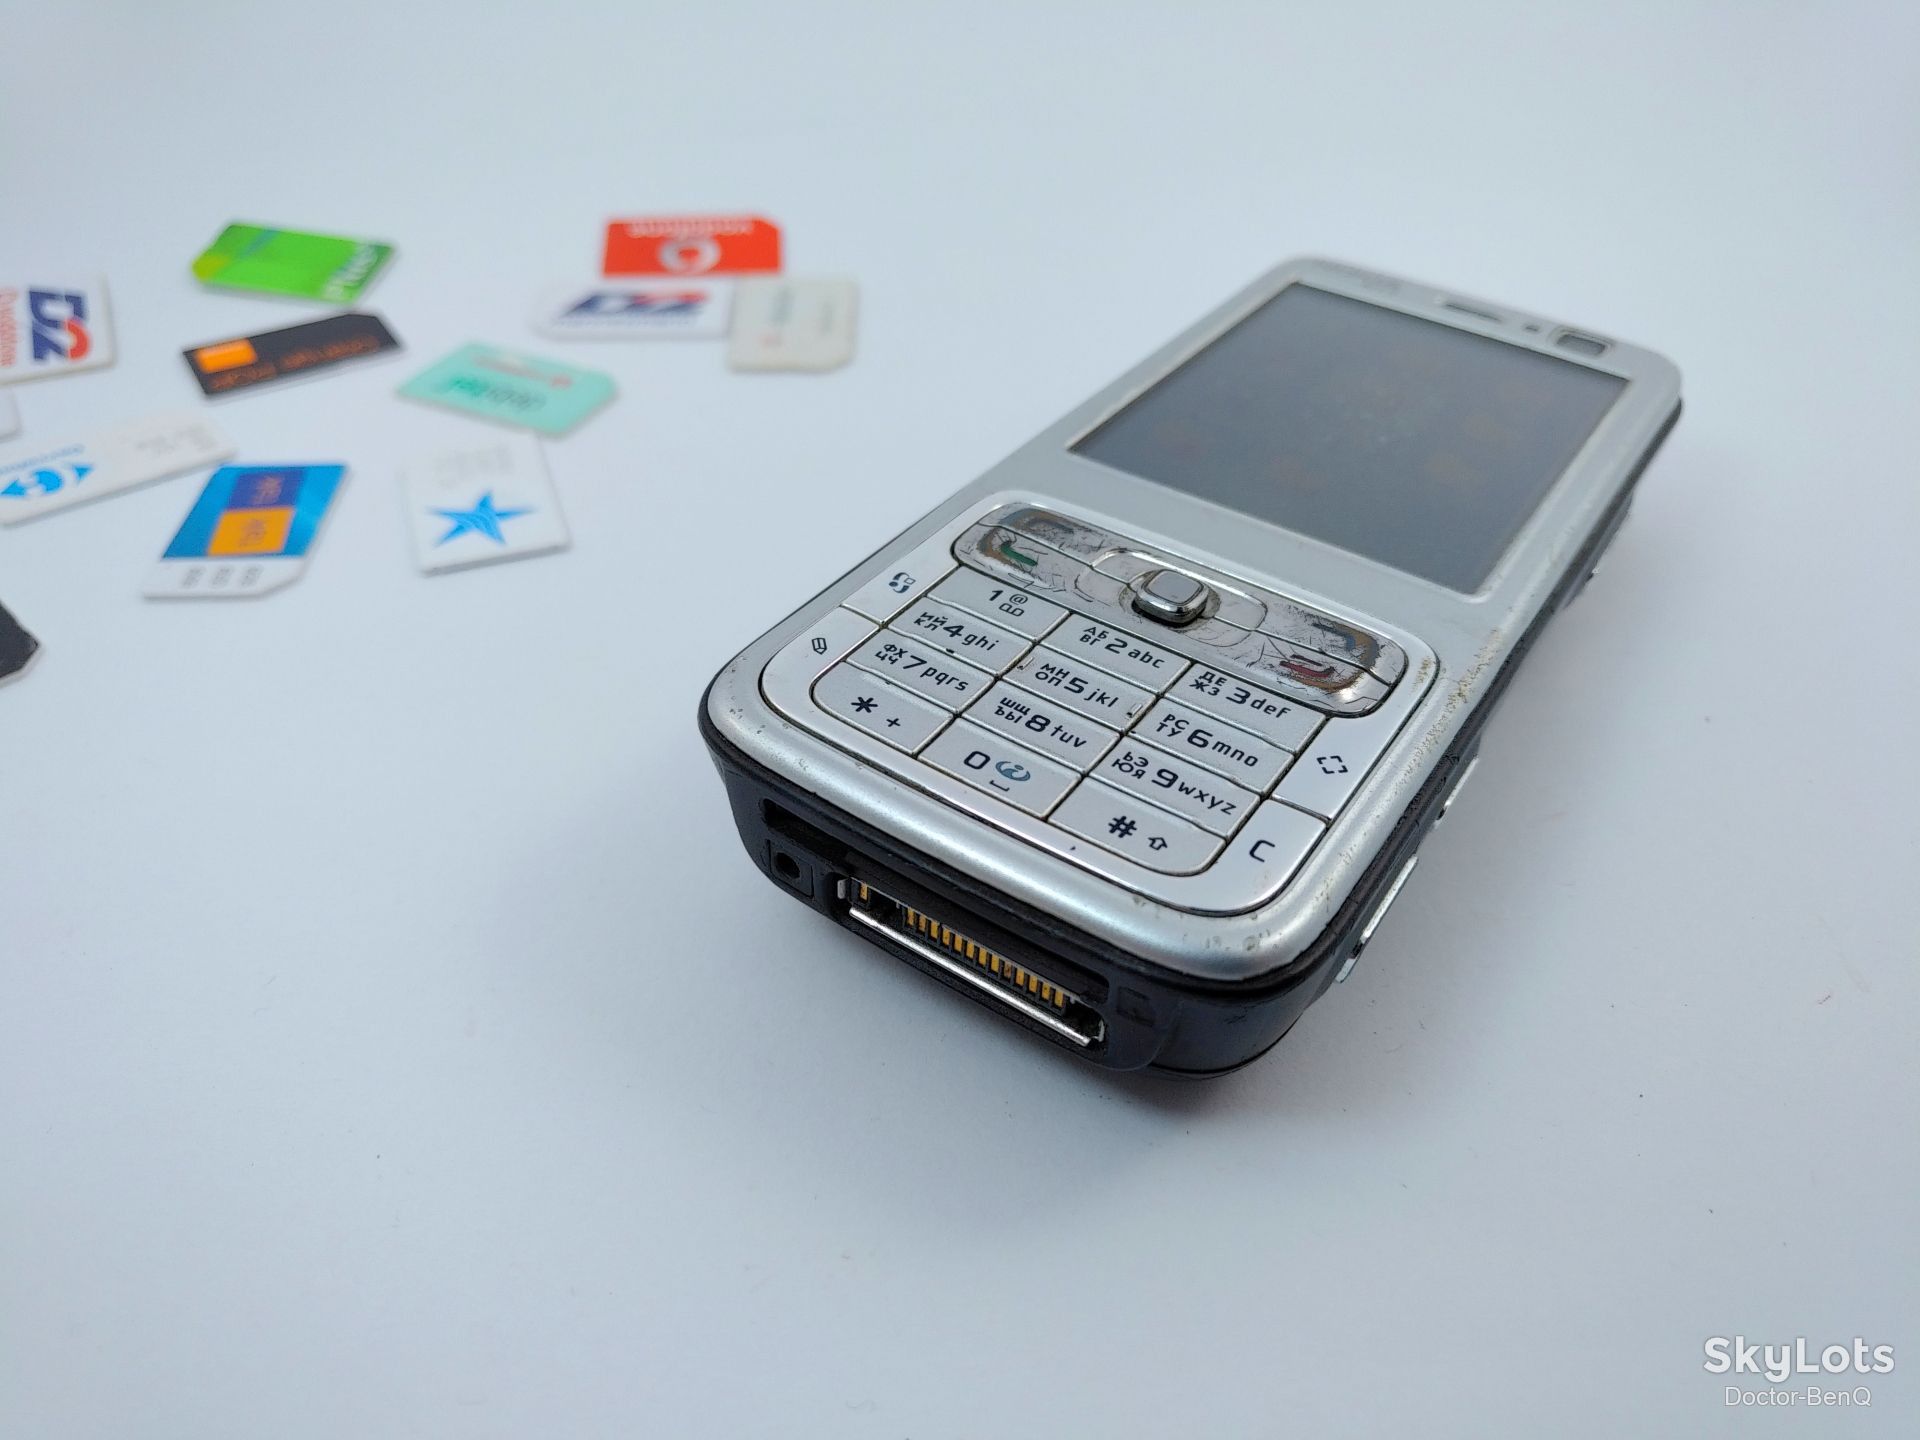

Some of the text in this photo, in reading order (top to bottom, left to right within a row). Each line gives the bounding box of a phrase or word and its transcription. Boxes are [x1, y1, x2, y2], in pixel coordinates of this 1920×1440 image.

[28, 289, 90, 361] D2
[987, 589, 1004, 602] 1
[943, 624, 1000, 652] 4 ghi
[1103, 637, 1166, 670] 2 abc
[902, 654, 970, 691] 7 pqrs
[1063, 676, 1120, 708] 5 jkl
[1225, 686, 1293, 719] 3 def
[1024, 713, 1088, 748] 8 tuv
[1186, 729, 1259, 768] 6 mno
[1151, 768, 1238, 815] 9 wxyz
[1249, 839, 1276, 863] C
